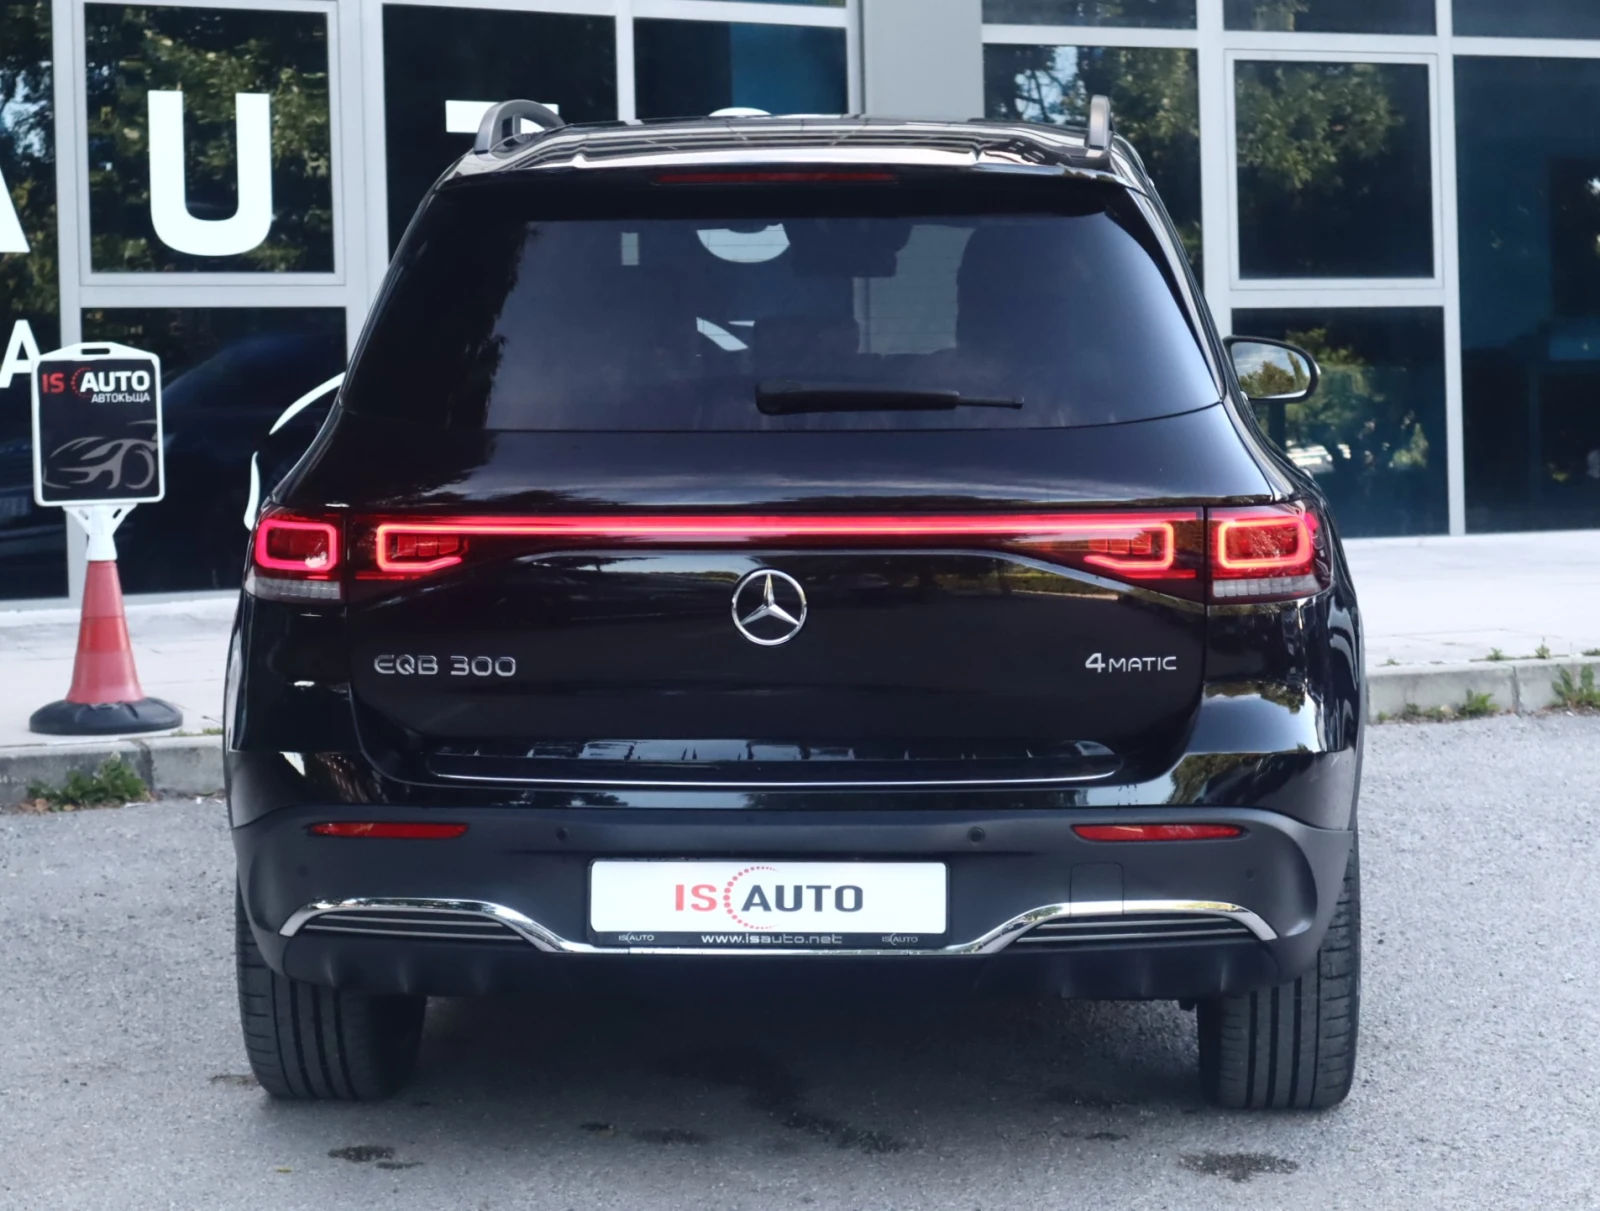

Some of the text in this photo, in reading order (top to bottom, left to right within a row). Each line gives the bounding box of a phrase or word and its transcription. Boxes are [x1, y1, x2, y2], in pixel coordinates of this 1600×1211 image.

[42, 370, 150, 393] IS AUTO
[374, 655, 516, 677] EQB 300
[675, 884, 864, 912] IS AUTO
[701, 933, 843, 944] www.isauto.net
